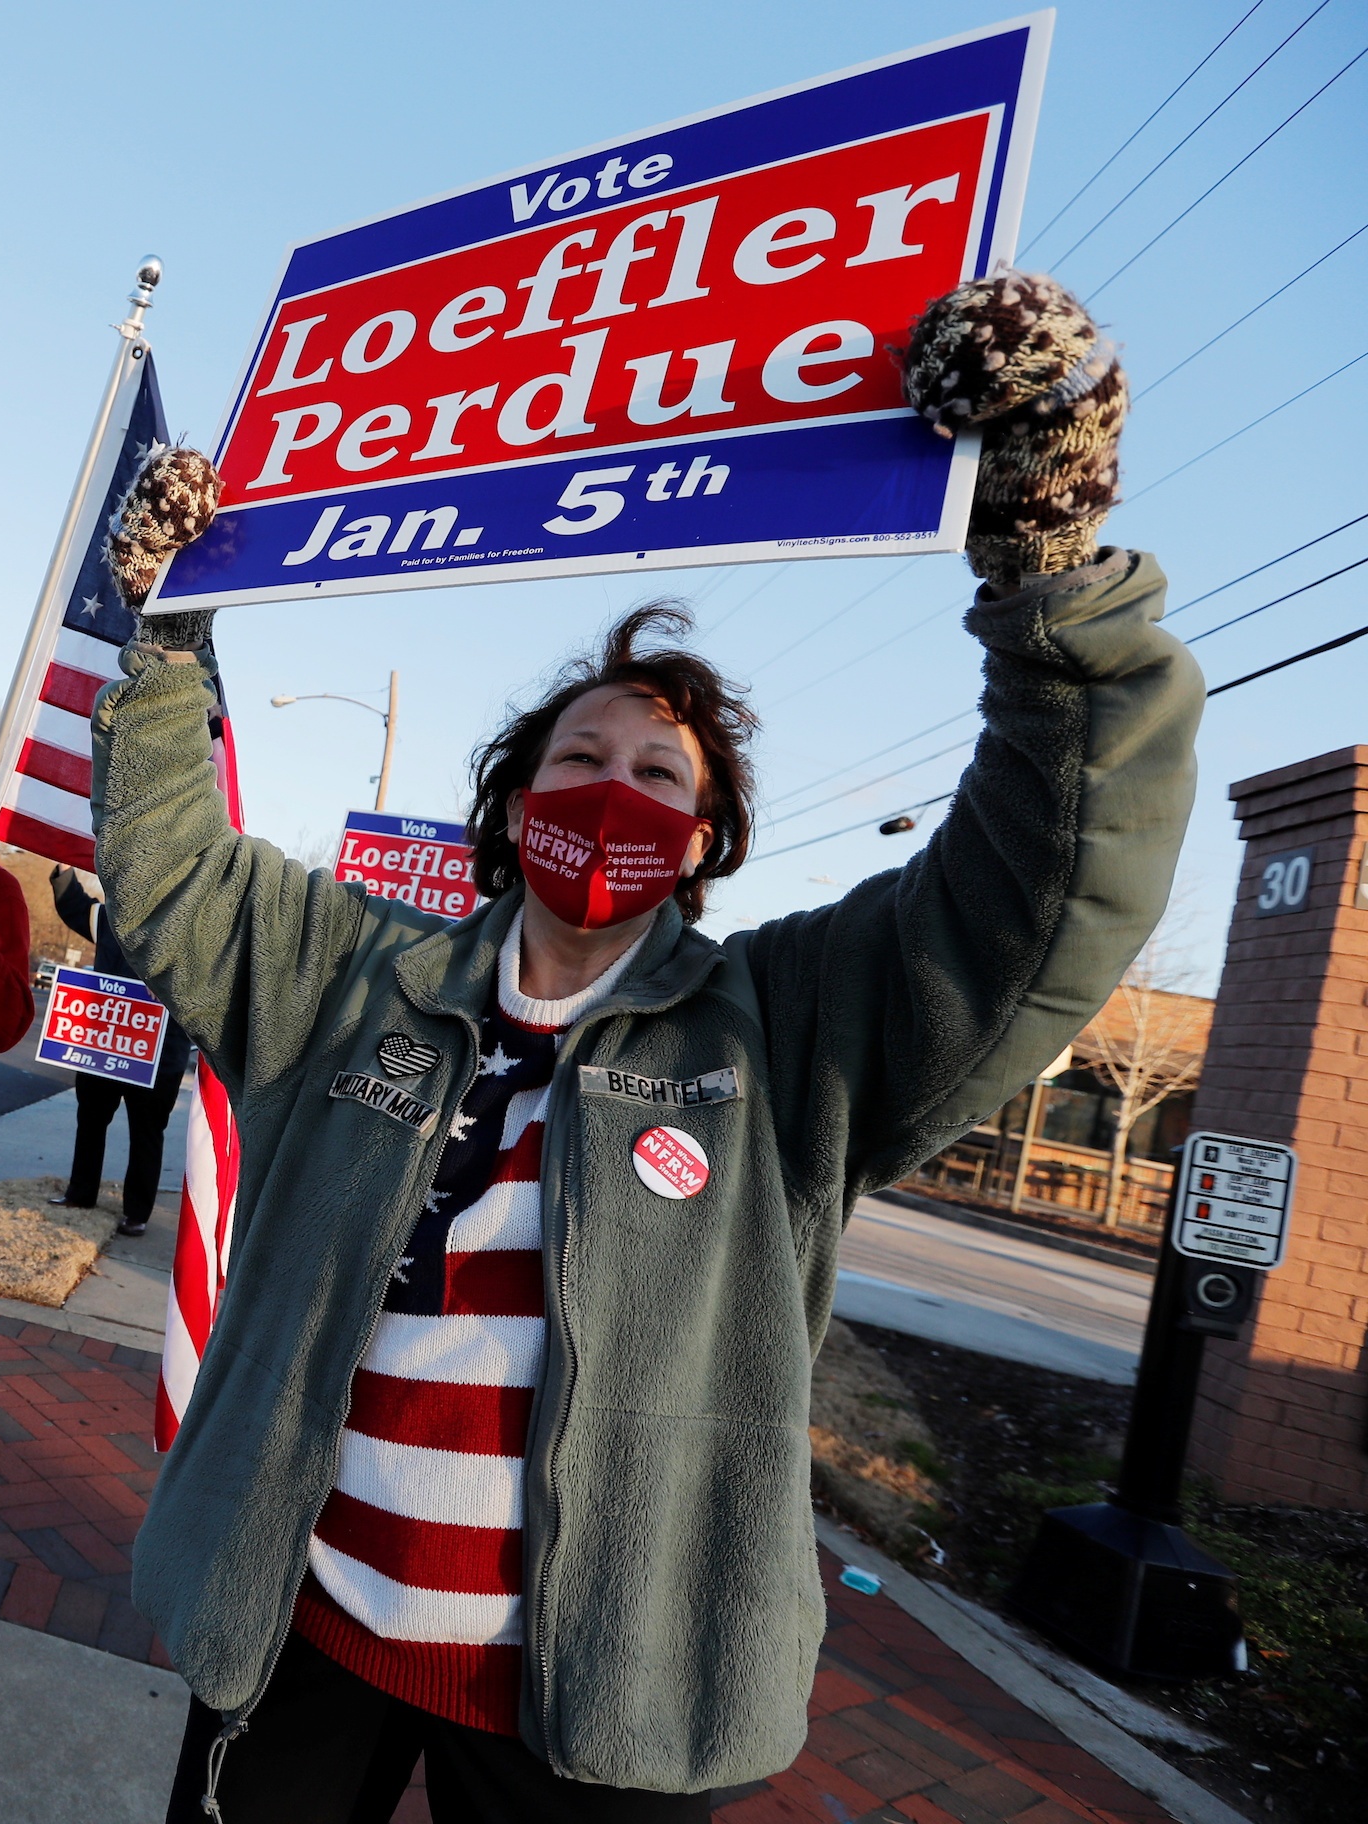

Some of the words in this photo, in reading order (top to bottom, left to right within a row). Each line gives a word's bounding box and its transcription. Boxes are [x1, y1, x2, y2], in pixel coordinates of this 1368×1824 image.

[510, 152, 674, 224] Vote
[256, 171, 961, 397] Loeffler
[245, 319, 875, 490] Perdue
[282, 505, 485, 567] Jan.
[542, 455, 732, 536] 5th
[401, 557, 420, 567] Paid
[421, 557, 435, 565] for
[436, 556, 447, 565] by
[448, 553, 485, 563] Families
[487, 550, 501, 559] for
[502, 547, 544, 557] Freedom
[777, 535, 870, 548] VinyltechSigns.com
[872, 531, 939, 542] 800-552-9517
[400, 819, 438, 838] Vote
[529, 816, 546, 831] Ask
[547, 823, 565, 837] Me
[567, 830, 595, 851] What
[340, 838, 475, 883] Loeffler
[526, 828, 592, 868] NFRW
[526, 849, 558, 872] Stands
[559, 864, 580, 880] For
[605, 842, 657, 853] National
[606, 855, 665, 865] Federation
[605, 868, 618, 878] of
[621, 868, 675, 880] Republican
[605, 880, 643, 891] Women
[1258, 856, 1311, 910] 30
[98, 978, 126, 994] Vote
[53, 991, 161, 1033] Loeffler
[53, 1016, 149, 1057] Perdue
[62, 1047, 97, 1067] Jan.
[104, 1056, 130, 1071] 5th
[332, 1074, 394, 1107] MILITARY
[386, 1092, 434, 1127] MOM
[607, 1070, 712, 1107] BECHTEL
[641, 1135, 702, 1187] NFRW
[651, 1129, 666, 1142] Ask
[664, 1140, 677, 1152] Me
[676, 1148, 695, 1167] What
[657, 1163, 680, 1185] Stands
[679, 1182, 693, 1196] For
